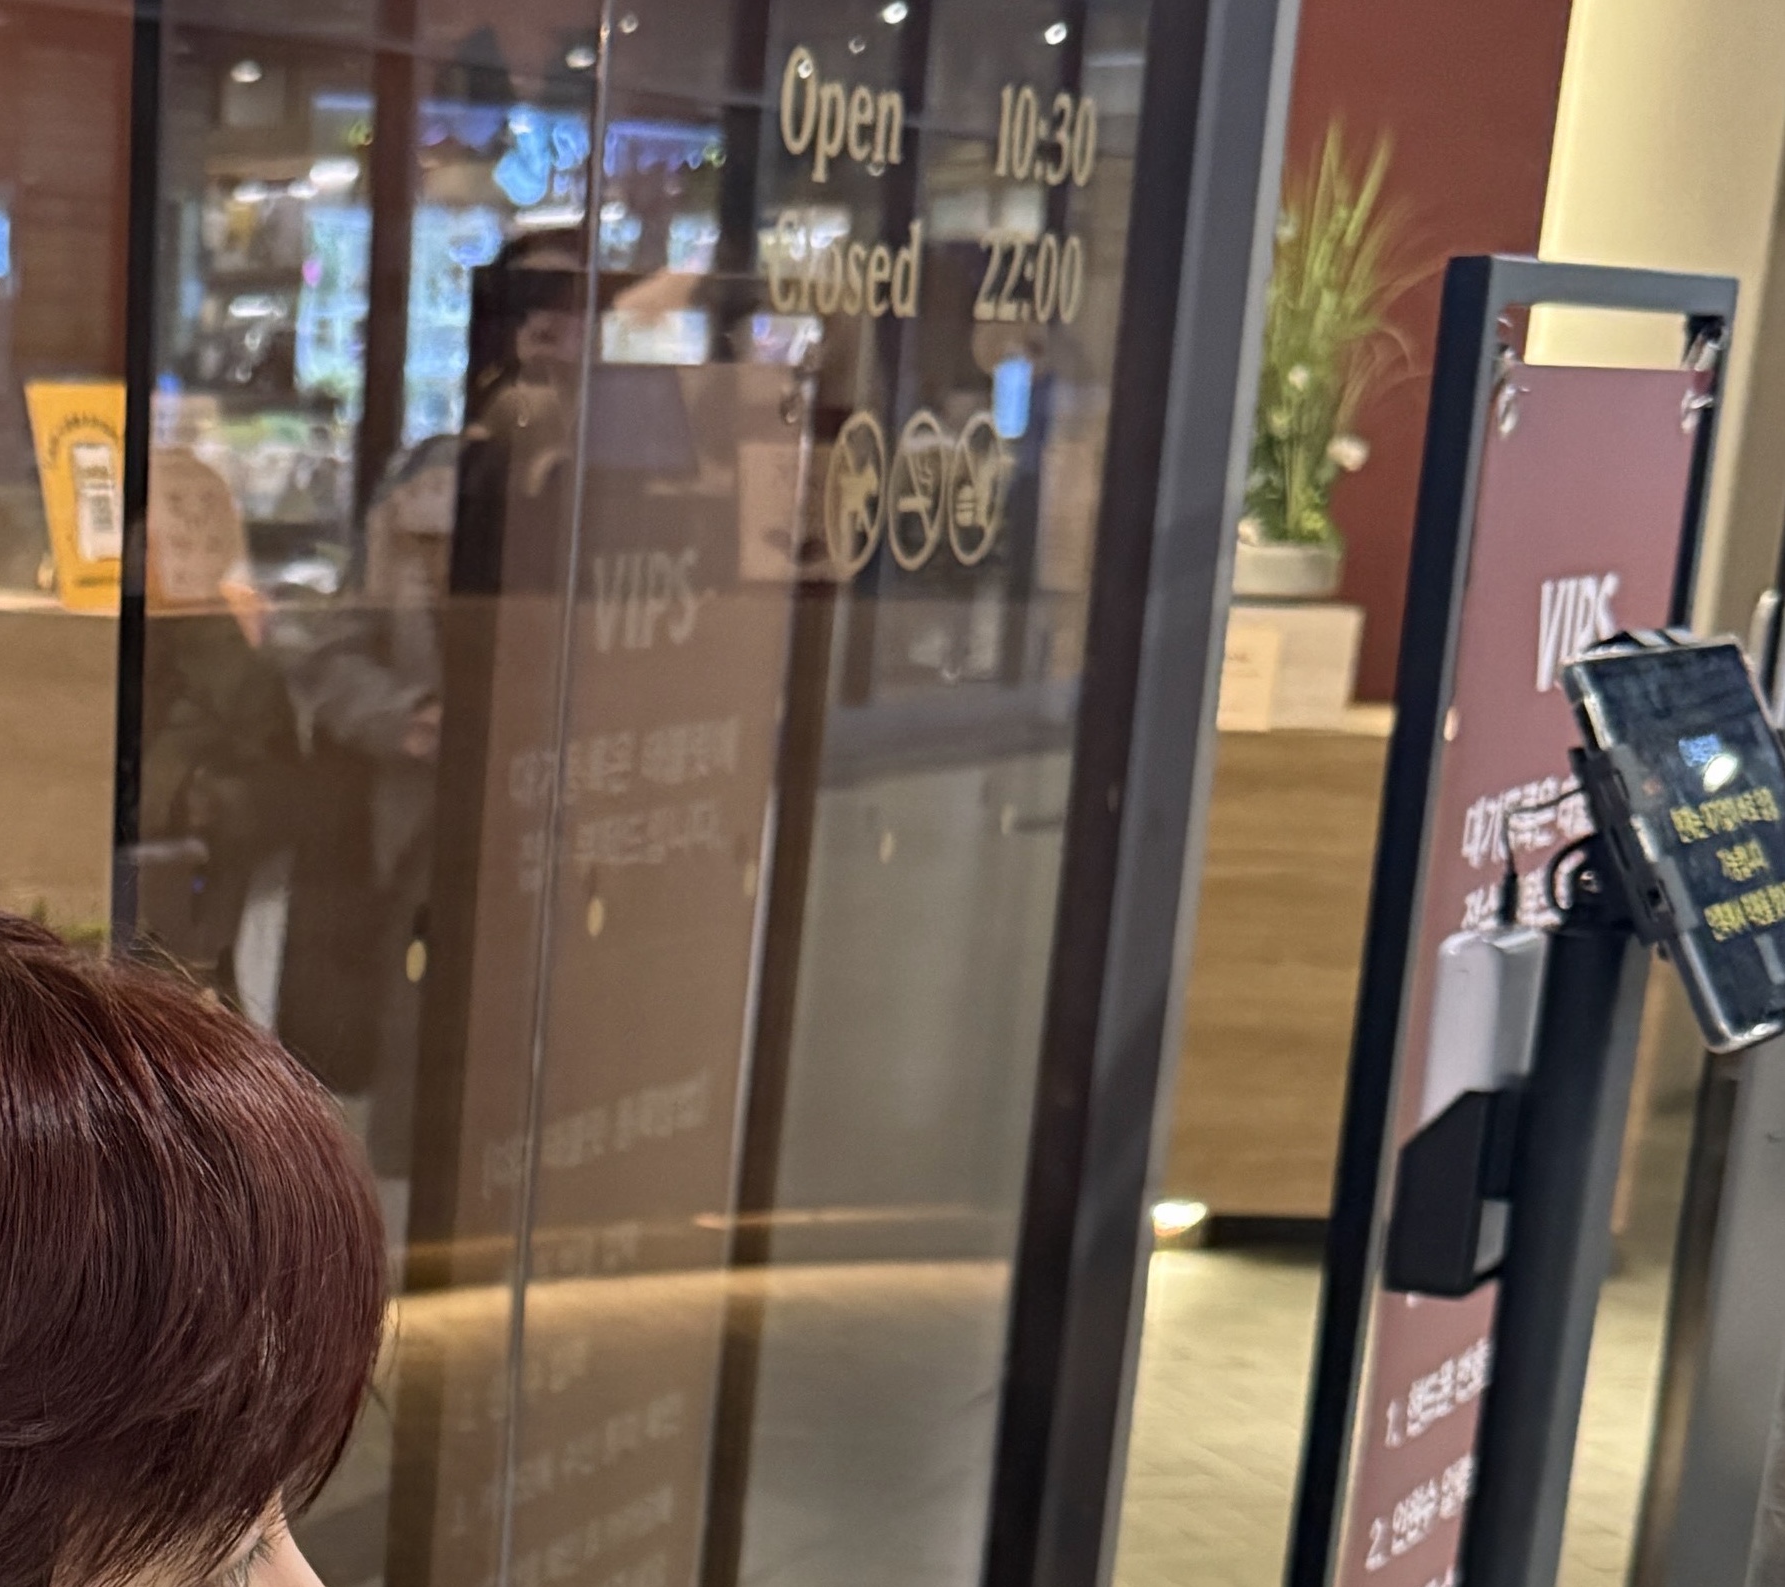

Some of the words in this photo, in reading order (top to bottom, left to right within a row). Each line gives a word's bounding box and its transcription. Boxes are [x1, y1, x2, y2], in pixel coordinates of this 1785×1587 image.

[780, 46, 905, 183] Open
[995, 82, 1098, 188] 10:30
[768, 208, 923, 318] Closed
[972, 232, 1083, 324] 22:00
[593, 547, 701, 653] VIPS
